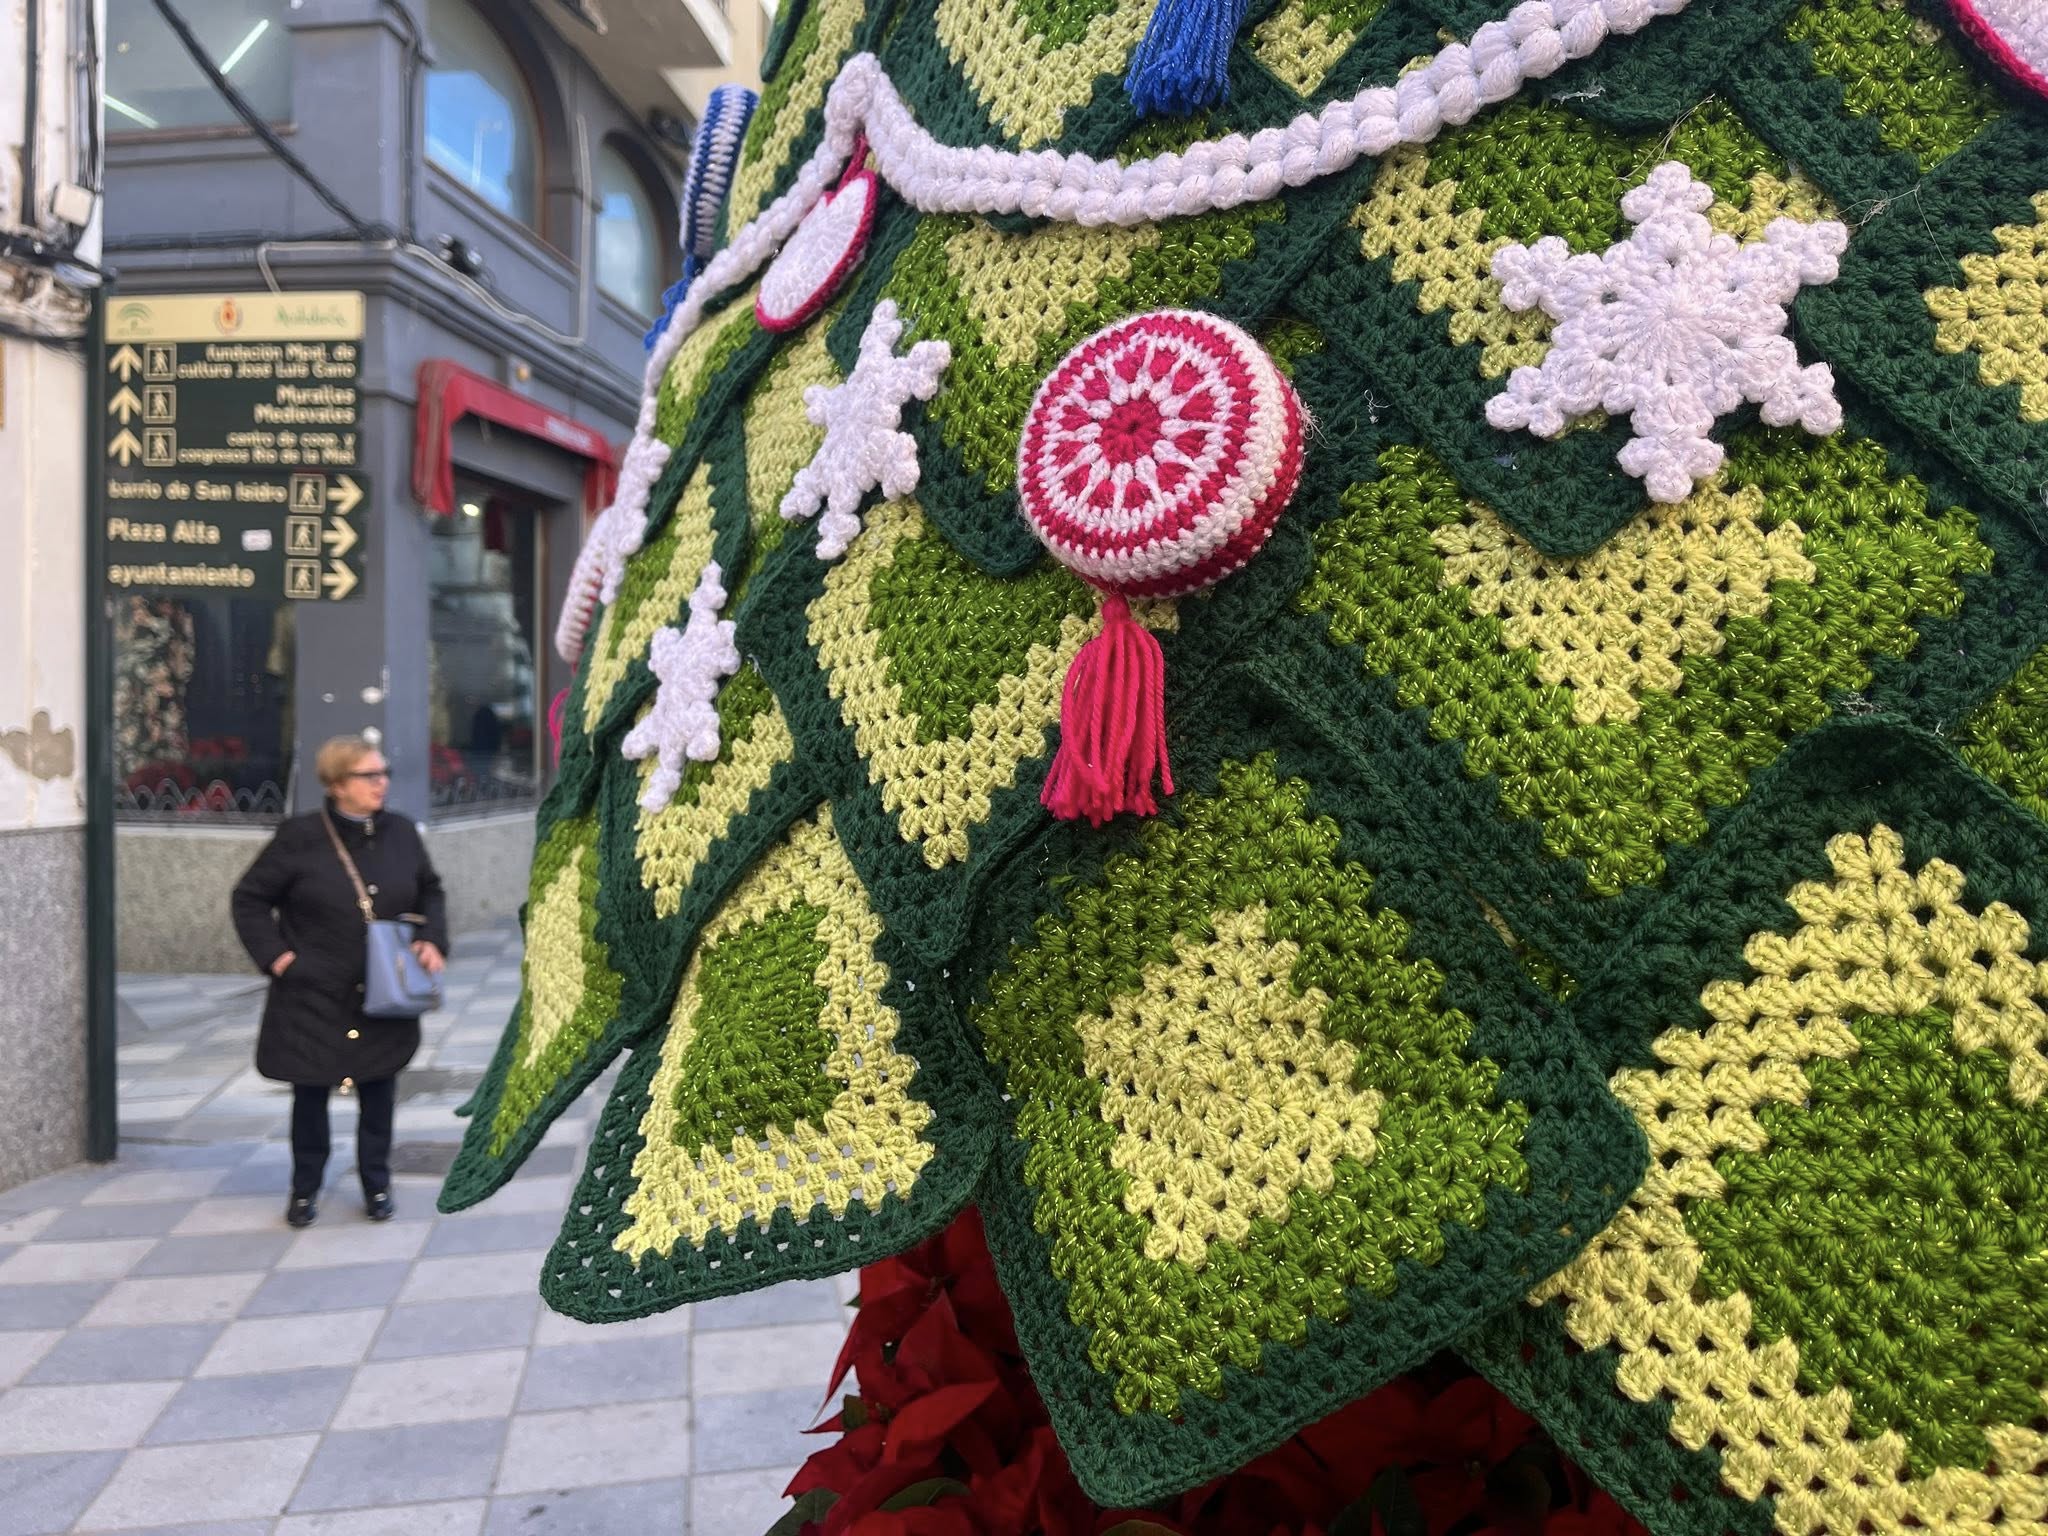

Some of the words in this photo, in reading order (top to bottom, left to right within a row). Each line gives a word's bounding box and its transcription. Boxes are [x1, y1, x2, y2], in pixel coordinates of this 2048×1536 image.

[333, 343, 356, 361] de
[276, 360, 309, 378] Luis
[276, 385, 355, 404] Murallas
[254, 404, 355, 423] Medievales
[227, 431, 275, 447] centro
[277, 431, 297, 448] de
[280, 448, 301, 464] de
[107, 479, 161, 499] barrio
[165, 480, 190, 500] de
[194, 480, 232, 501] San
[235, 482, 287, 503] Isidro
[107, 517, 166, 542] Plaza
[172, 519, 220, 544] Alta
[108, 563, 255, 587] ayuntamiento
